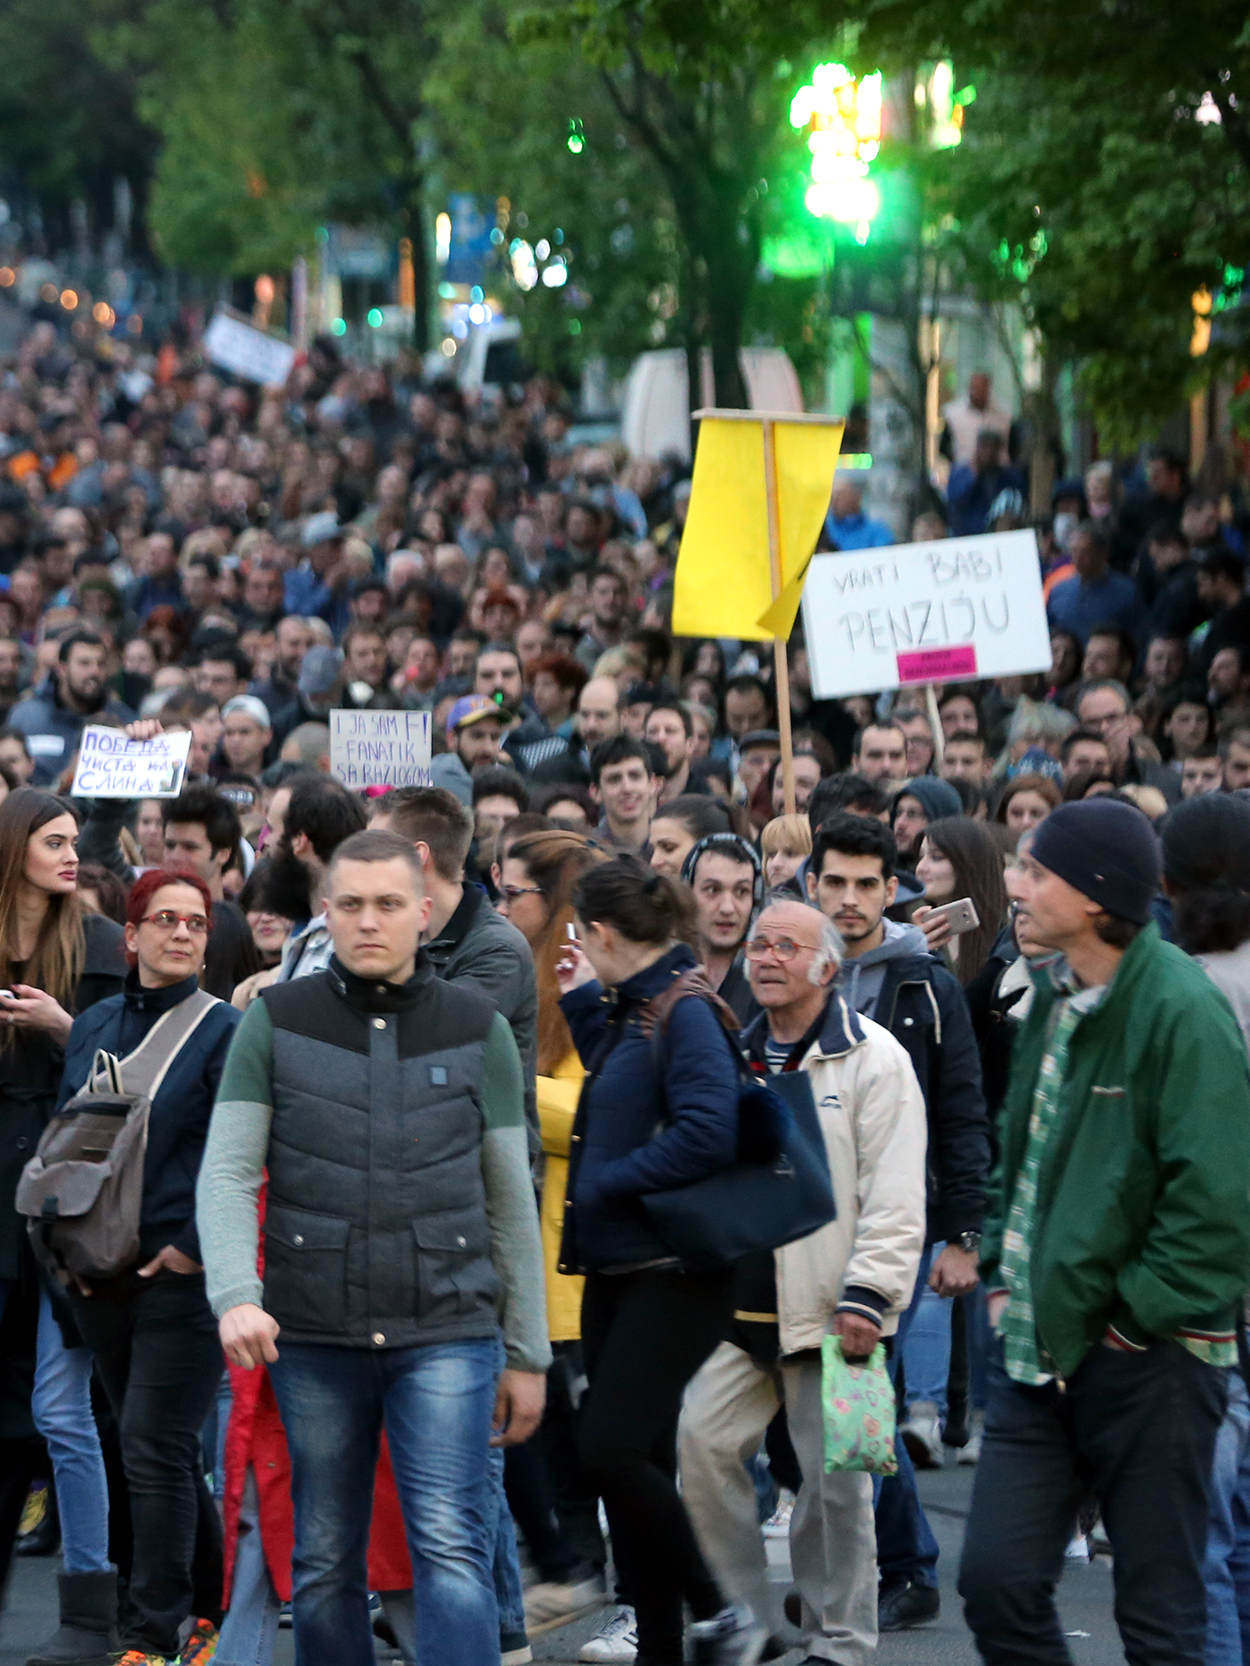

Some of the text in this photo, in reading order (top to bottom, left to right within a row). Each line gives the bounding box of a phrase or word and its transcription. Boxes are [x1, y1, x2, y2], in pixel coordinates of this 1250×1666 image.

[833, 548, 1003, 595] VRATI BABI
[839, 590, 1010, 651] PENZIJU
[350, 714, 367, 735] JA
[371, 713, 399, 736] SAM
[85, 732, 170, 756] ПОБЕДА
[78, 771, 155, 793] СЛИНА
